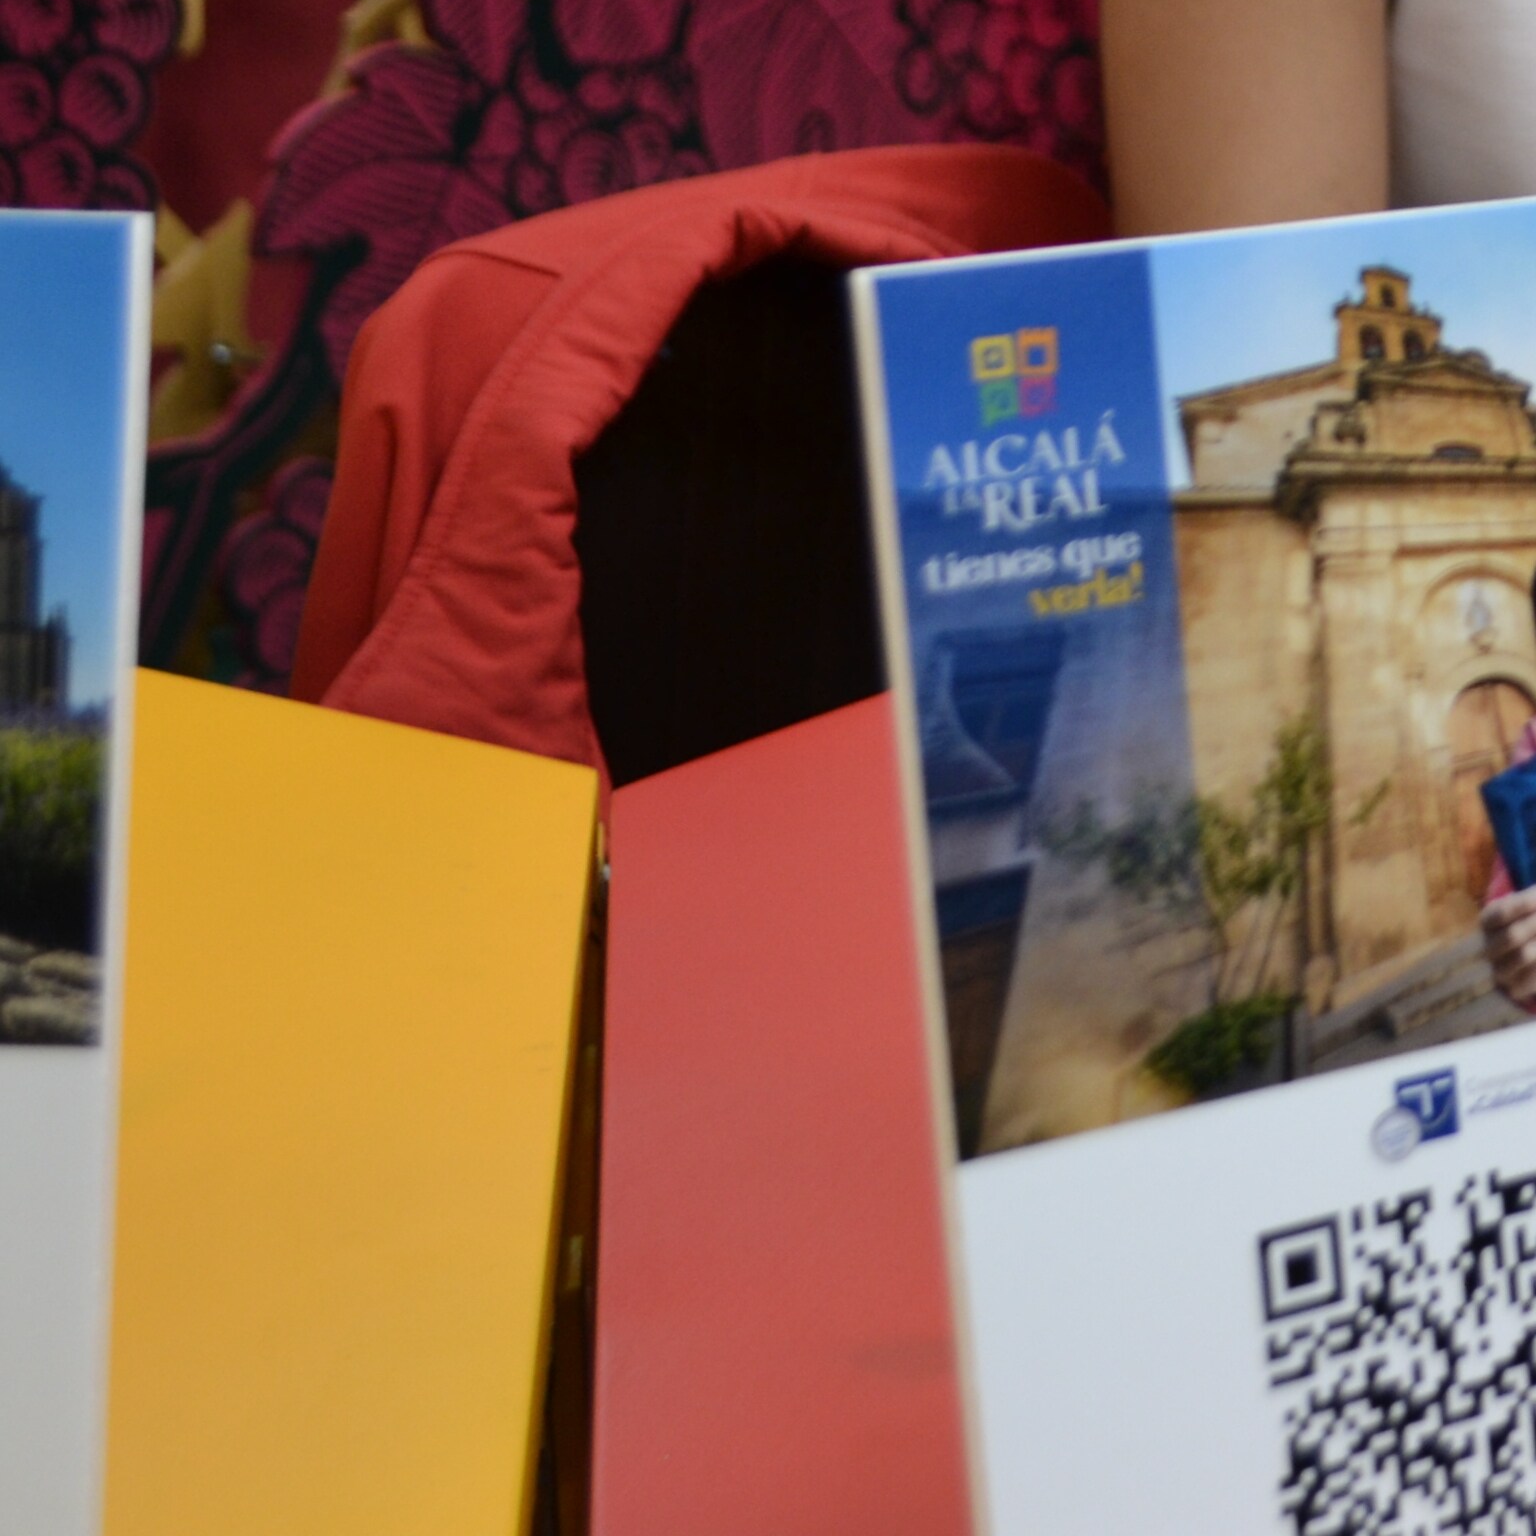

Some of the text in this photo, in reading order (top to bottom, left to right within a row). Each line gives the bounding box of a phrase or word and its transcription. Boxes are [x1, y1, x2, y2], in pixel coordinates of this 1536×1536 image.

[923, 409, 1127, 489] ALCALÁ
[981, 467, 1110, 533] REAL
[921, 530, 1143, 595] tienes que
[1028, 560, 1145, 622] verla!
